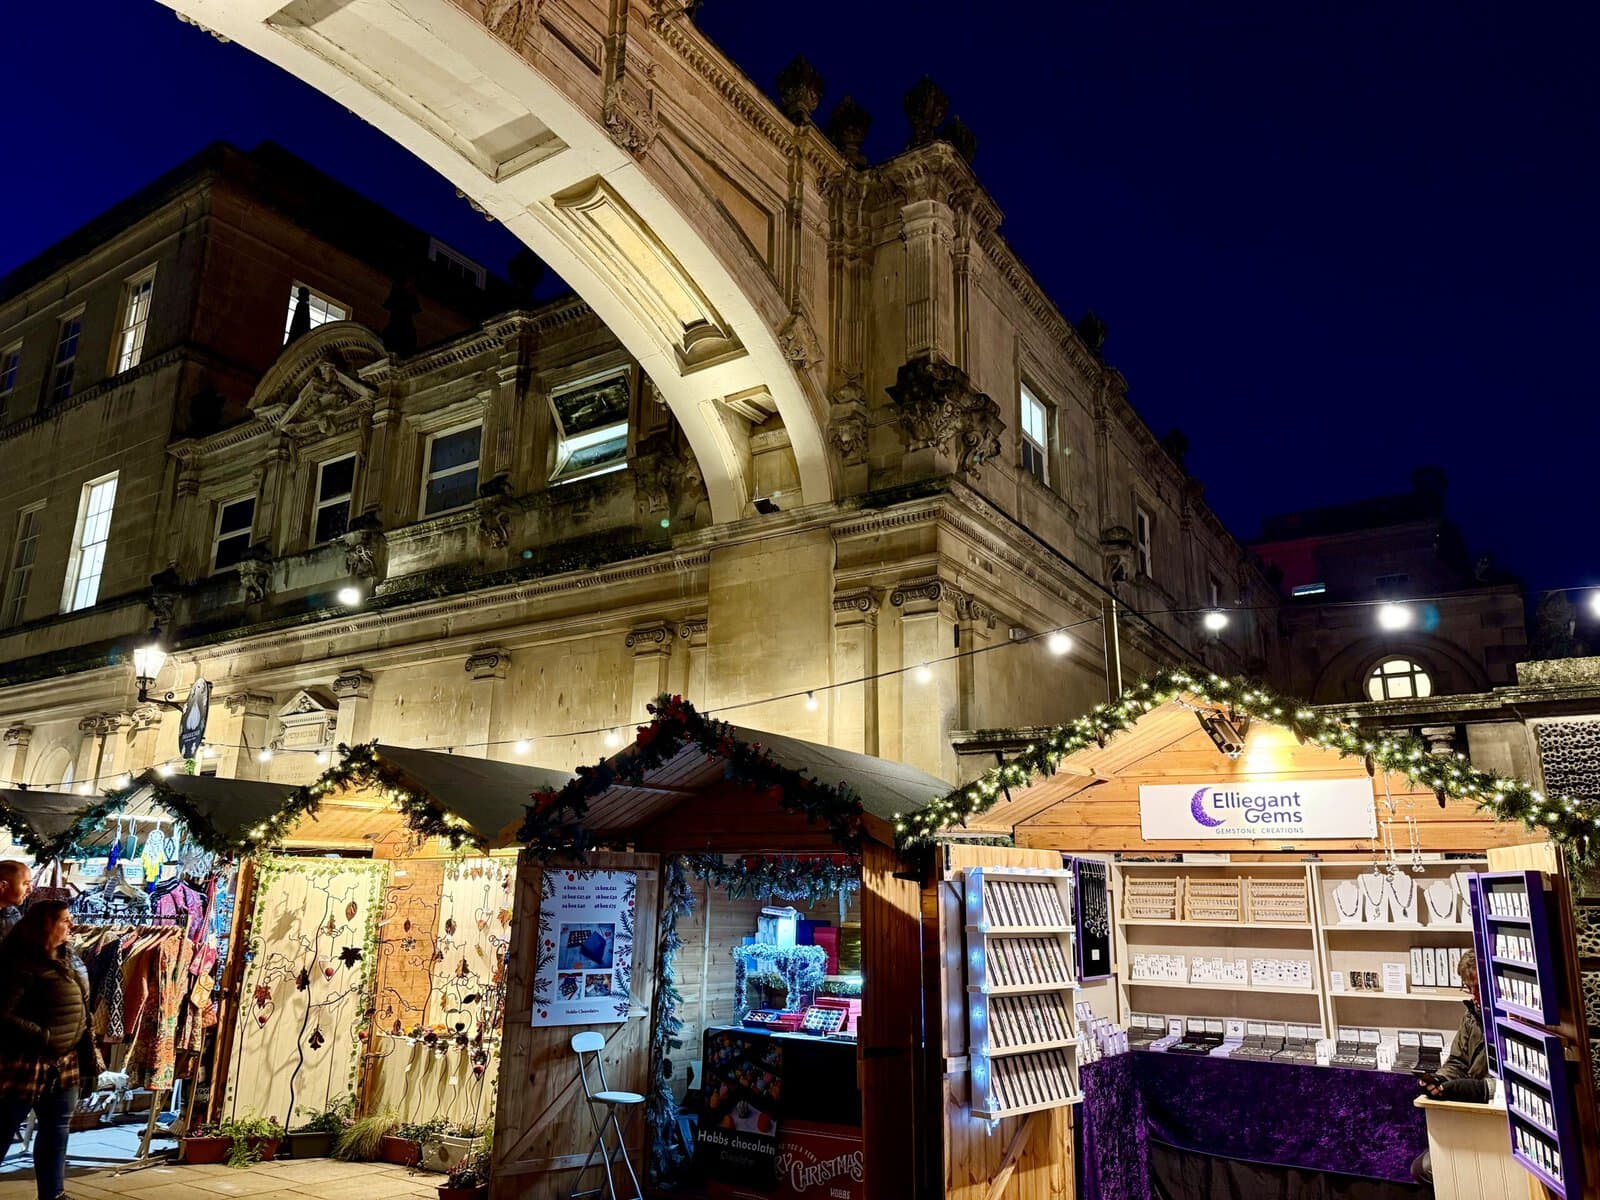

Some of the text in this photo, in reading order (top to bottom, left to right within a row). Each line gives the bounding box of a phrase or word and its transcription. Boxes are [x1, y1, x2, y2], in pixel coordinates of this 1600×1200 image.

[1213, 791, 1301, 812] Elliegant
[1245, 808, 1303, 823] Gems
[1215, 826, 1305, 835] GEMSTONE CREATIONS
[697, 1128, 729, 1146] Hobbs
[790, 1150, 865, 1193] CHRISTMAS
[830, 1187, 851, 1200] HOBBS
